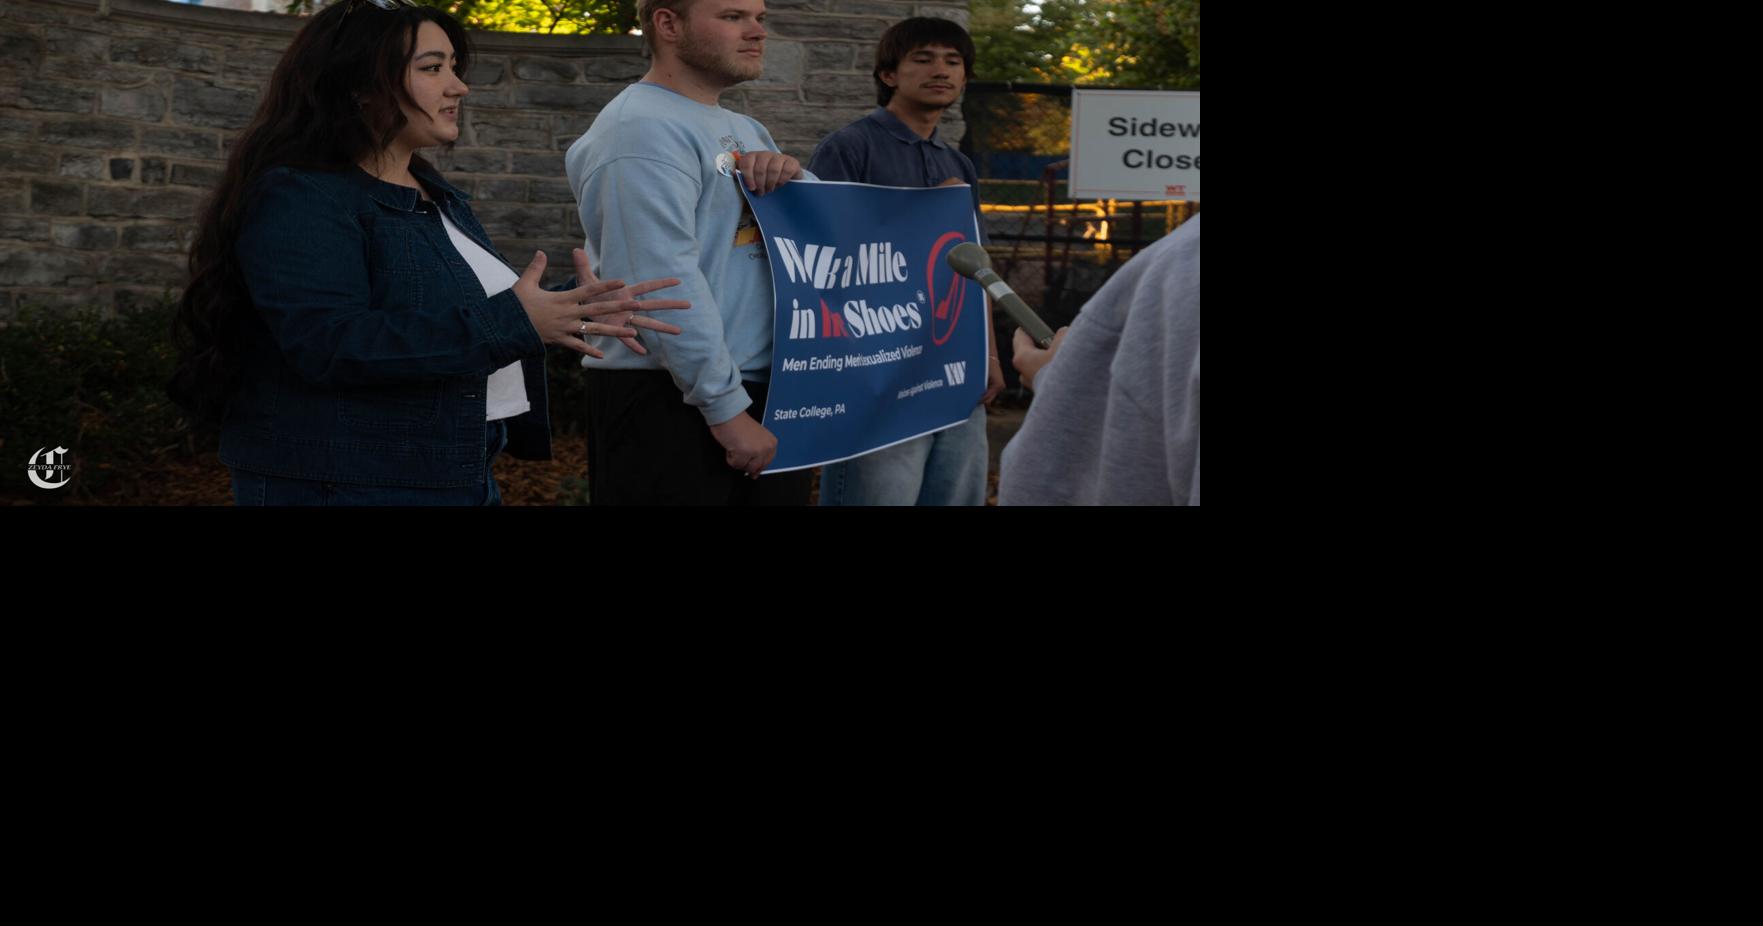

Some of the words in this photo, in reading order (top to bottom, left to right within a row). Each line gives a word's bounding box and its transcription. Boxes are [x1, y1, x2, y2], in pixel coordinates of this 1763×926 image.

[841, 255, 853, 288] a
[855, 241, 908, 286] Mile
[789, 298, 816, 340] in
[782, 358, 807, 372] Men
[809, 355, 843, 372] Ending
[774, 407, 797, 421] State
[799, 404, 833, 419] College,
[834, 403, 846, 415] PA
